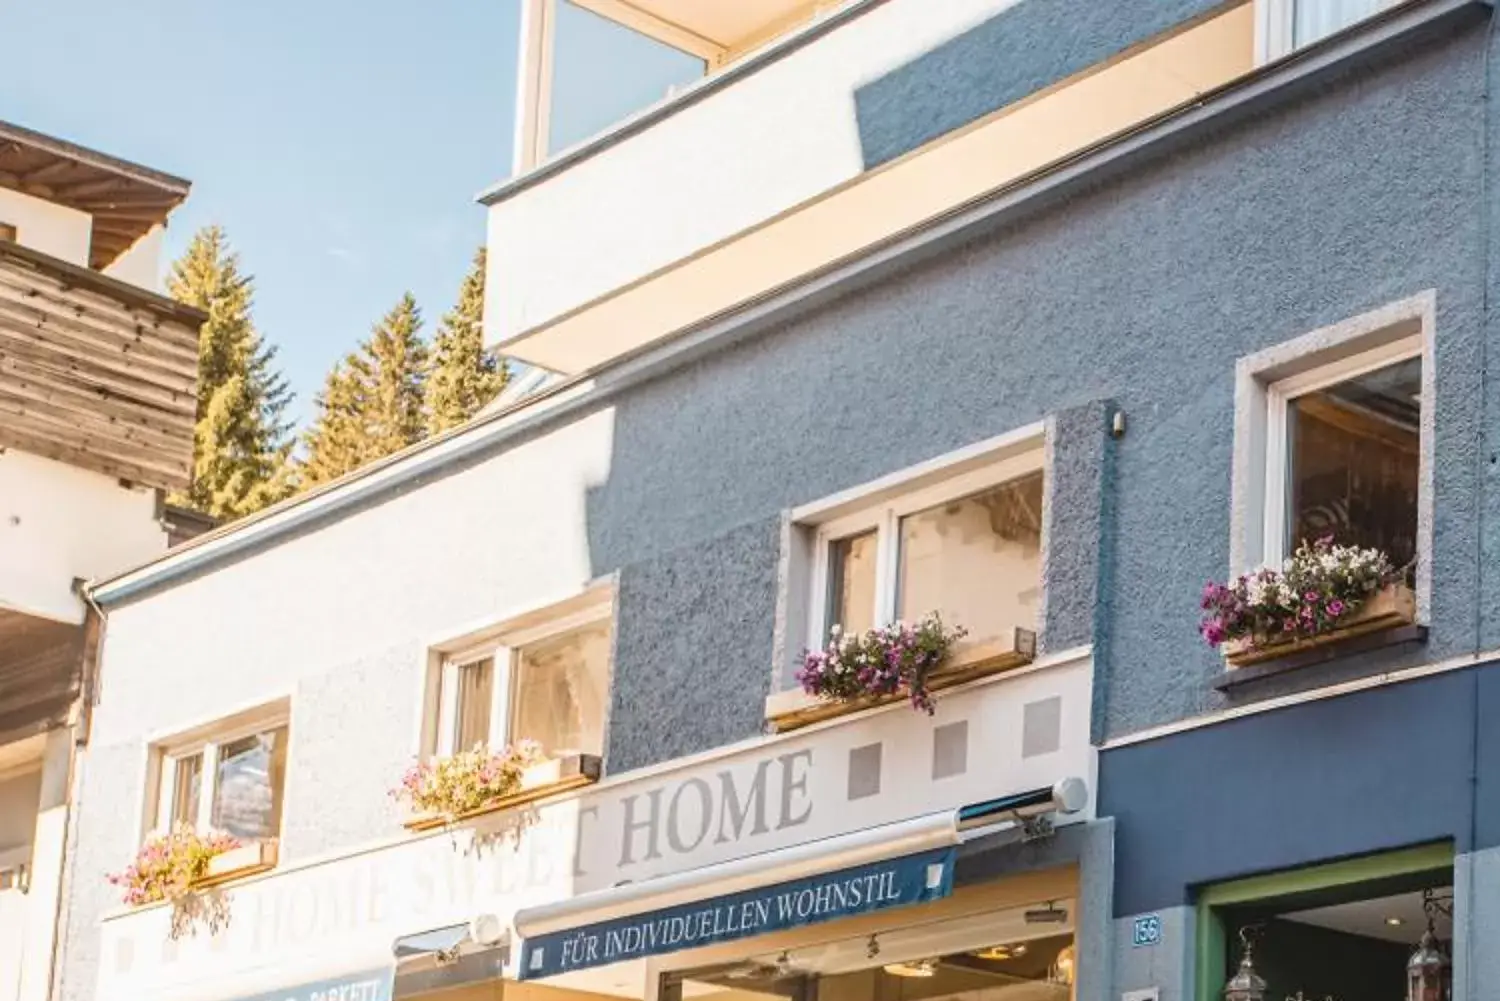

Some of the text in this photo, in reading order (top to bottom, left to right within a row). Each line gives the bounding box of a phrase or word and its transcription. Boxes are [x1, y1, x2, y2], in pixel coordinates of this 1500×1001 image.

[618, 748, 814, 867] HOME
[560, 870, 901, 967] FÜR INDIVIDUELLEN WOHNSTIL
